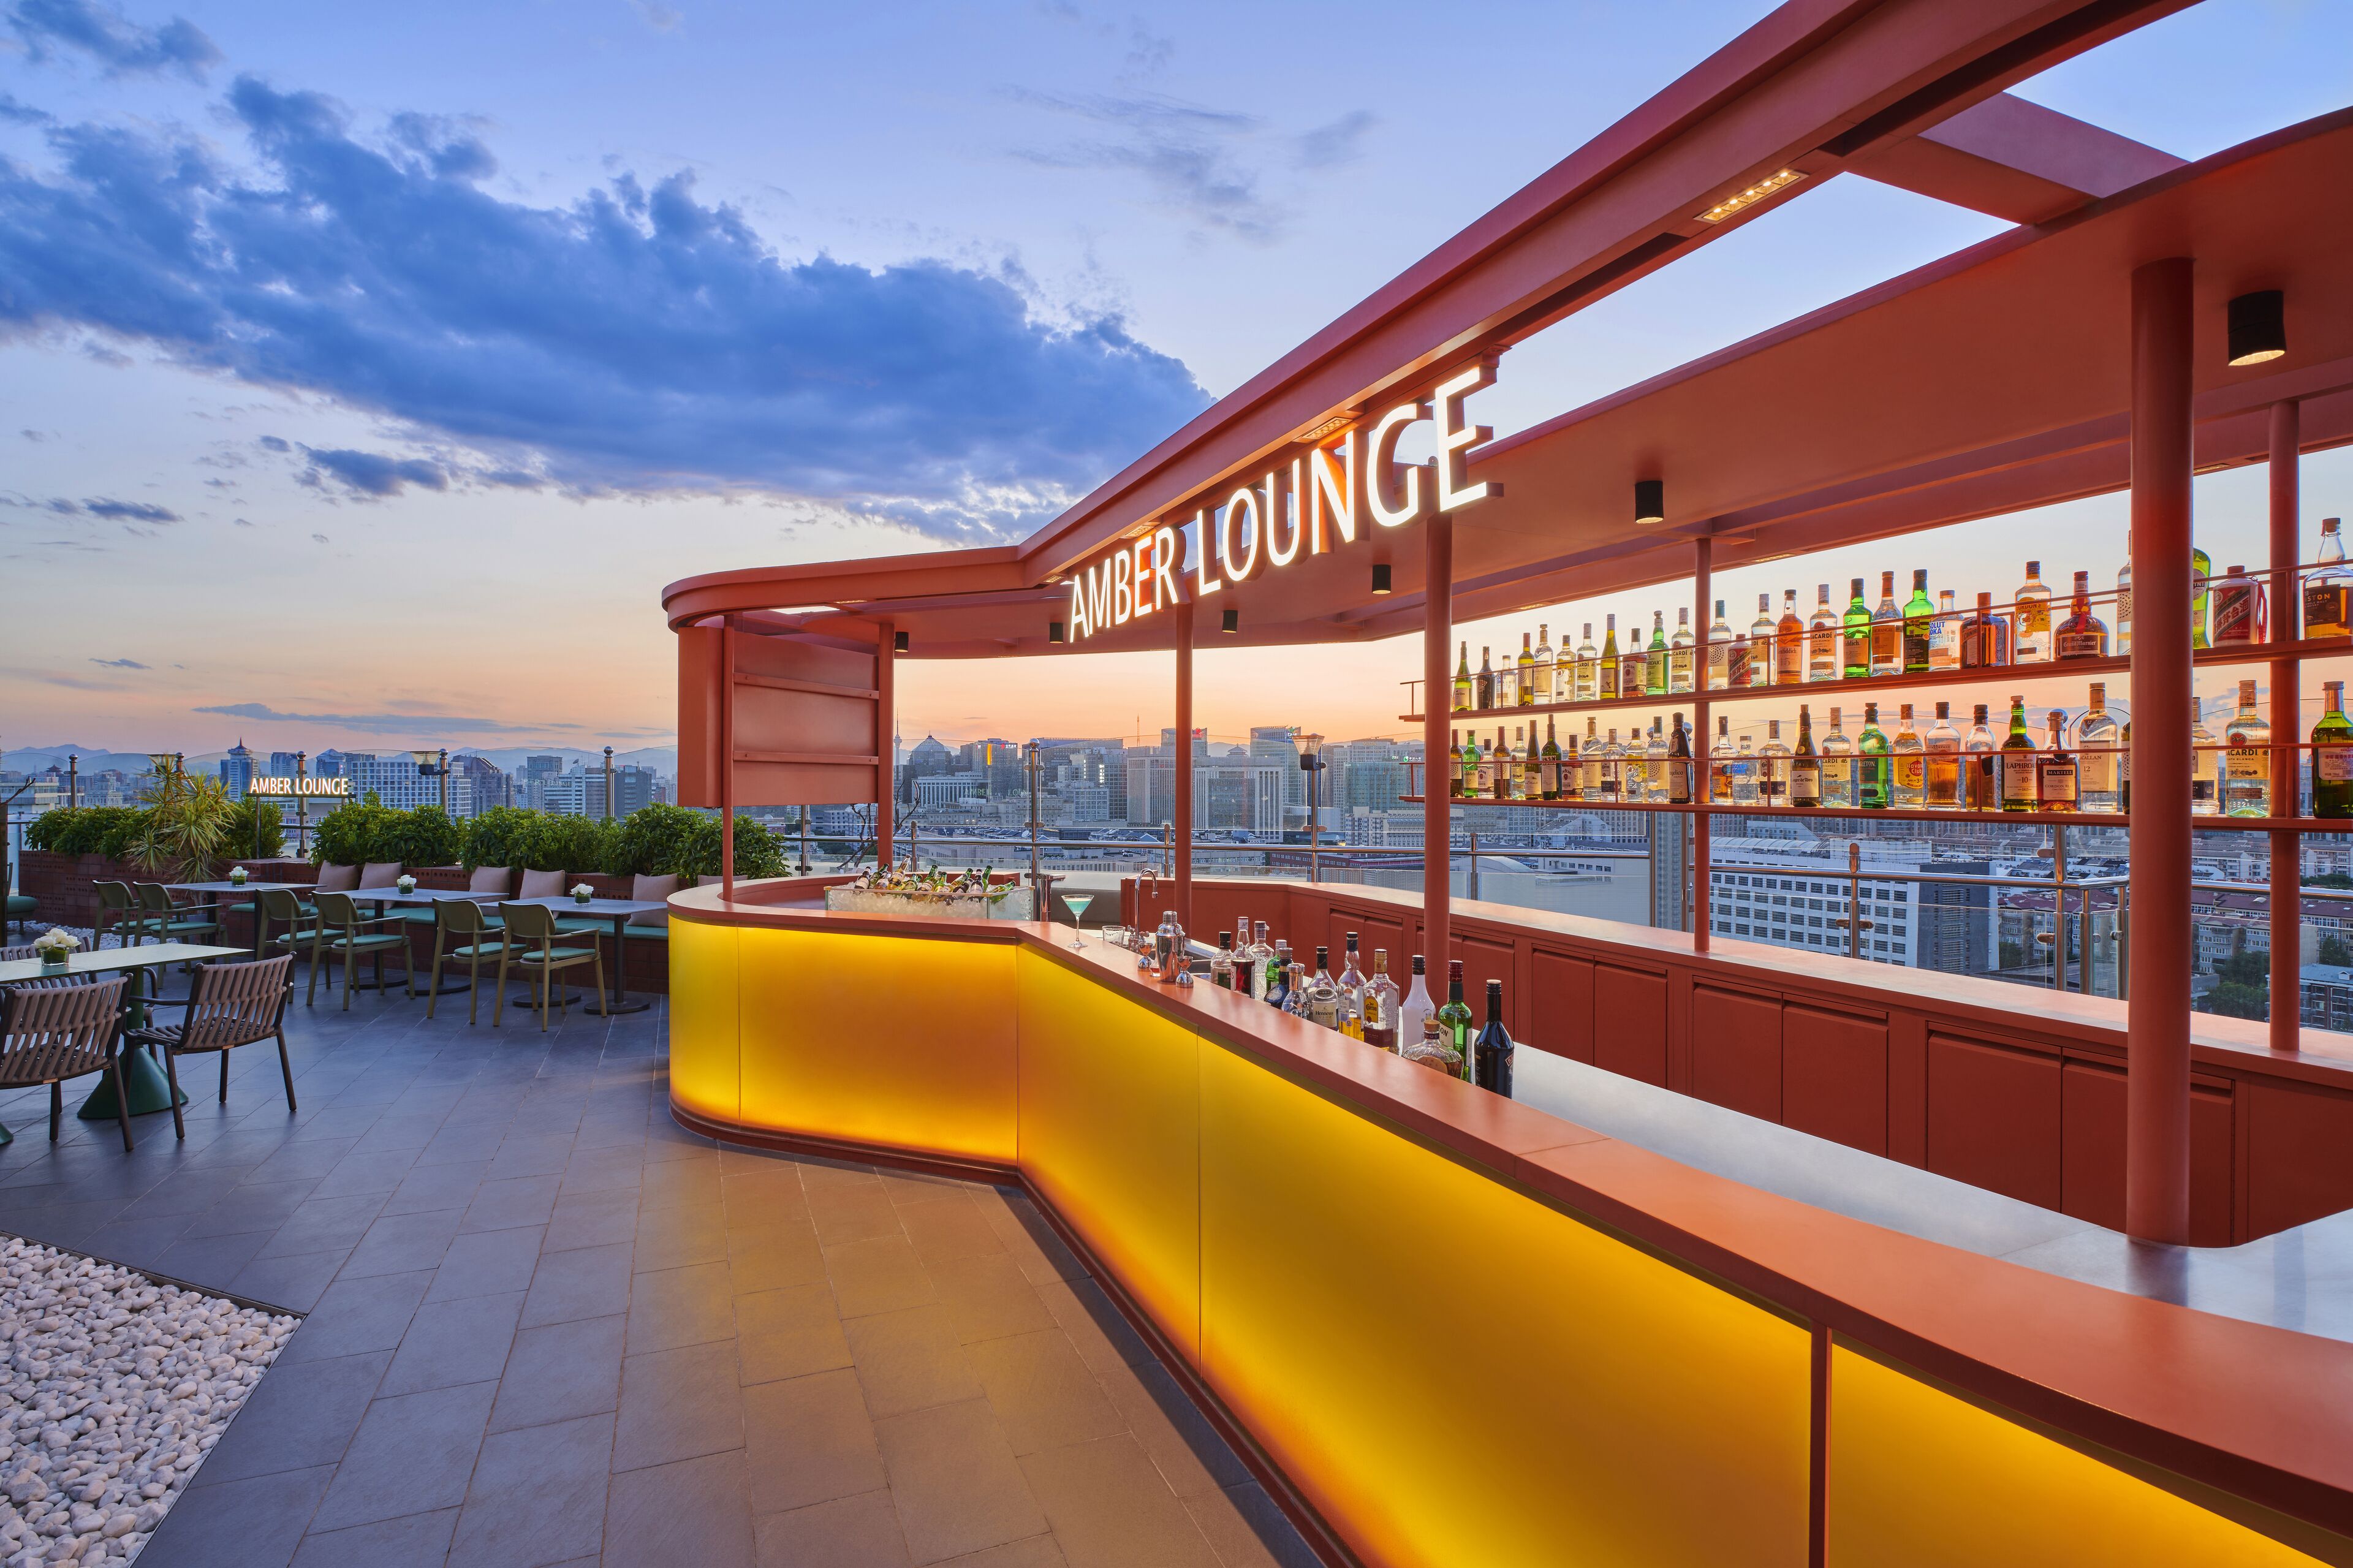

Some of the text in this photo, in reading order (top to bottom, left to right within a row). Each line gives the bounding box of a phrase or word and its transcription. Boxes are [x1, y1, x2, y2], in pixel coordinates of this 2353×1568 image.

[1070, 366, 1490, 643] AMBER LOUNGE
[2305, 593, 2331, 602] STON
[250, 778, 348, 795] AMBER LOUNGE
